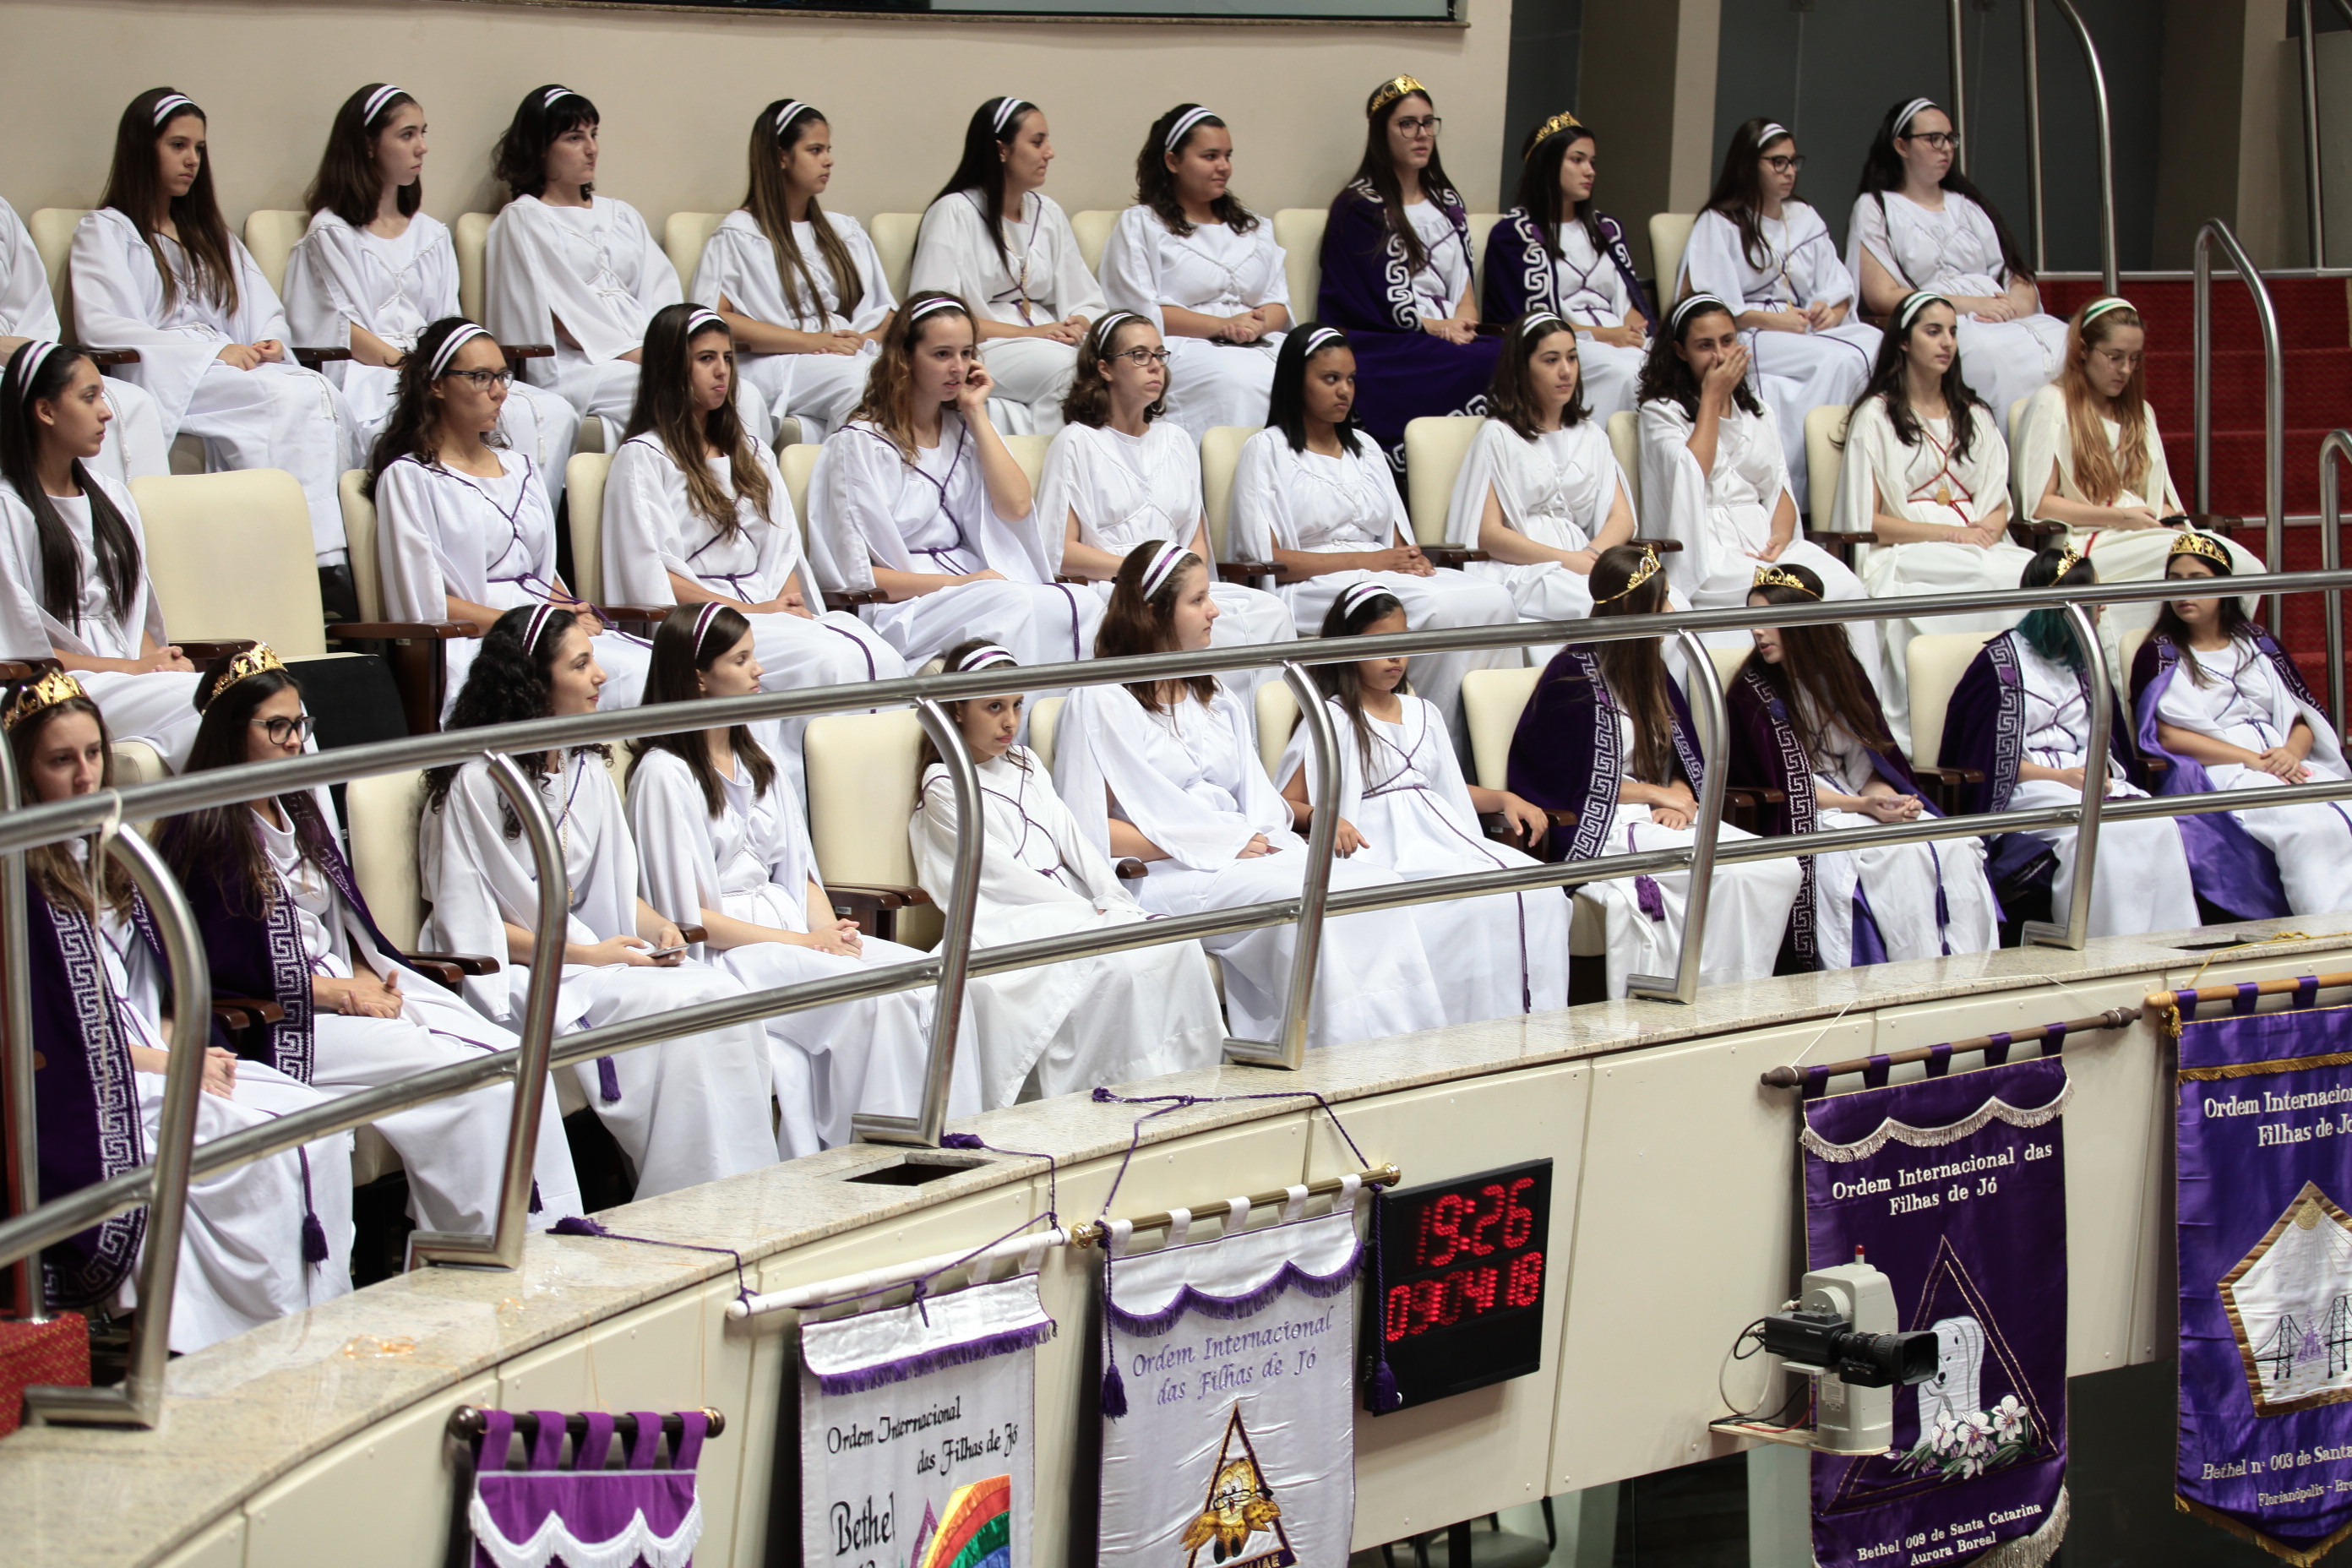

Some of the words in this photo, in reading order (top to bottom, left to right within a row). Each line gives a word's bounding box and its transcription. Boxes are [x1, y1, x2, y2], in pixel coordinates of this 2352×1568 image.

[2204, 1095, 2260, 1119] Ordem
[2257, 1123, 2312, 1147] Filhas
[2316, 1117, 2333, 1138] de
[1832, 1178, 1892, 1200] Ordem
[1898, 1146, 2016, 1188] Internacional
[2024, 1143, 2053, 1162] das
[1889, 1191, 1940, 1217] Filhas
[1948, 1184, 1969, 1202] de
[1977, 1176, 1998, 1196] Jó
[1416, 1176, 1535, 1266] 19:26
[1133, 1343, 1195, 1377] Ordem
[1203, 1305, 1335, 1360] Internacional
[1157, 1377, 1186, 1405] das
[1197, 1363, 1254, 1400] Filhas
[1262, 1352, 1283, 1377] de
[1293, 1346, 1317, 1376] Jó
[827, 1424, 874, 1454] Ordem
[878, 1396, 961, 1443] Internacional
[917, 1449, 935, 1475] das
[940, 1436, 983, 1476] Filhas
[987, 1429, 1001, 1453] de
[2201, 1459, 2247, 1480] Bethel
[2270, 1452, 2293, 1471] 003
[2296, 1450, 2311, 1467] de
[2314, 1442, 2352, 1463] Santa
[2257, 1483, 2324, 1507] Florianópolis
[830, 1490, 896, 1556] Bethel
[1857, 1540, 1900, 1561] Bethel
[1905, 1533, 1926, 1549] 009
[1930, 1528, 1946, 1542] de
[1950, 1518, 1985, 1537] Santa
[1989, 1503, 2043, 1525] Catarina
[1910, 1546, 1953, 1566] Aurora
[1957, 1531, 1997, 1553] Boreal
